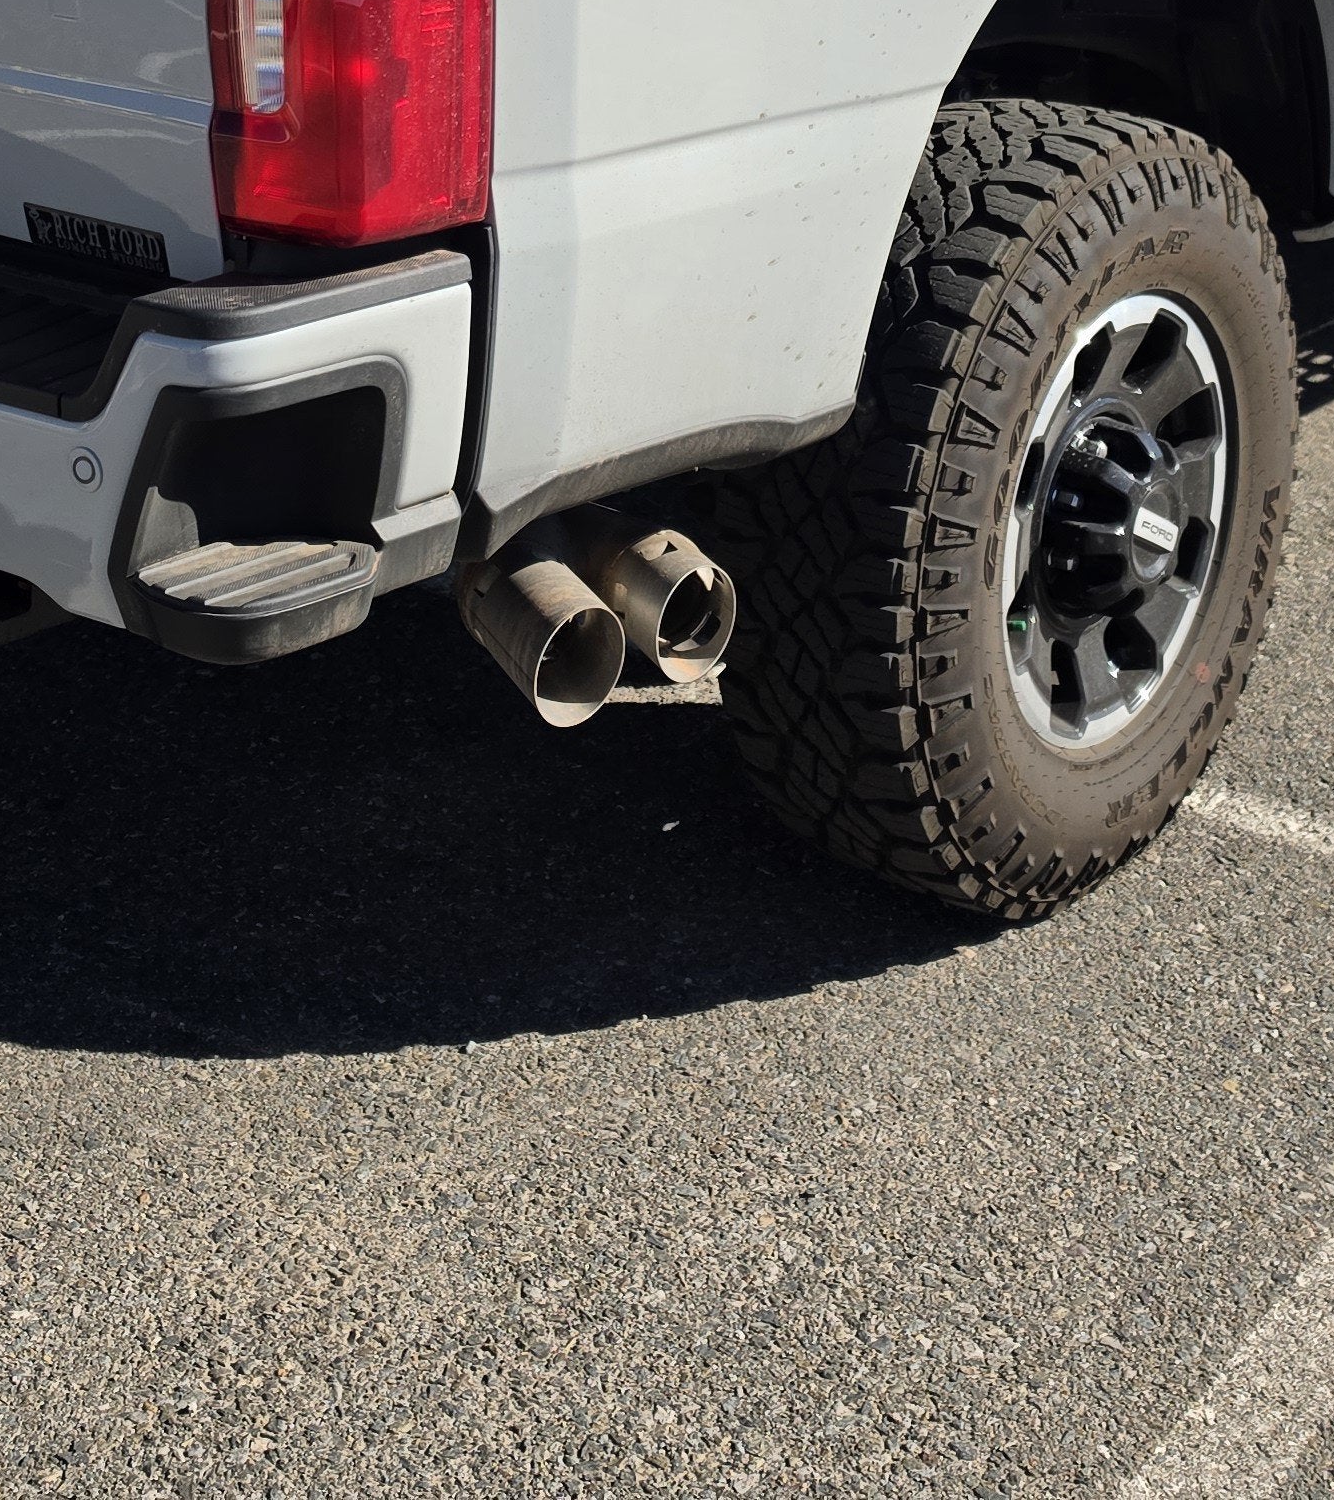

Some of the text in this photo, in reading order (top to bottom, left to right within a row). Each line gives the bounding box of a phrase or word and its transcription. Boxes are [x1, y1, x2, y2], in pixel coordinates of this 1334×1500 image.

[51, 211, 161, 261] RICH FORD
[1141, 520, 1174, 543] FORD
[1105, 481, 1282, 829] WRANGLER
